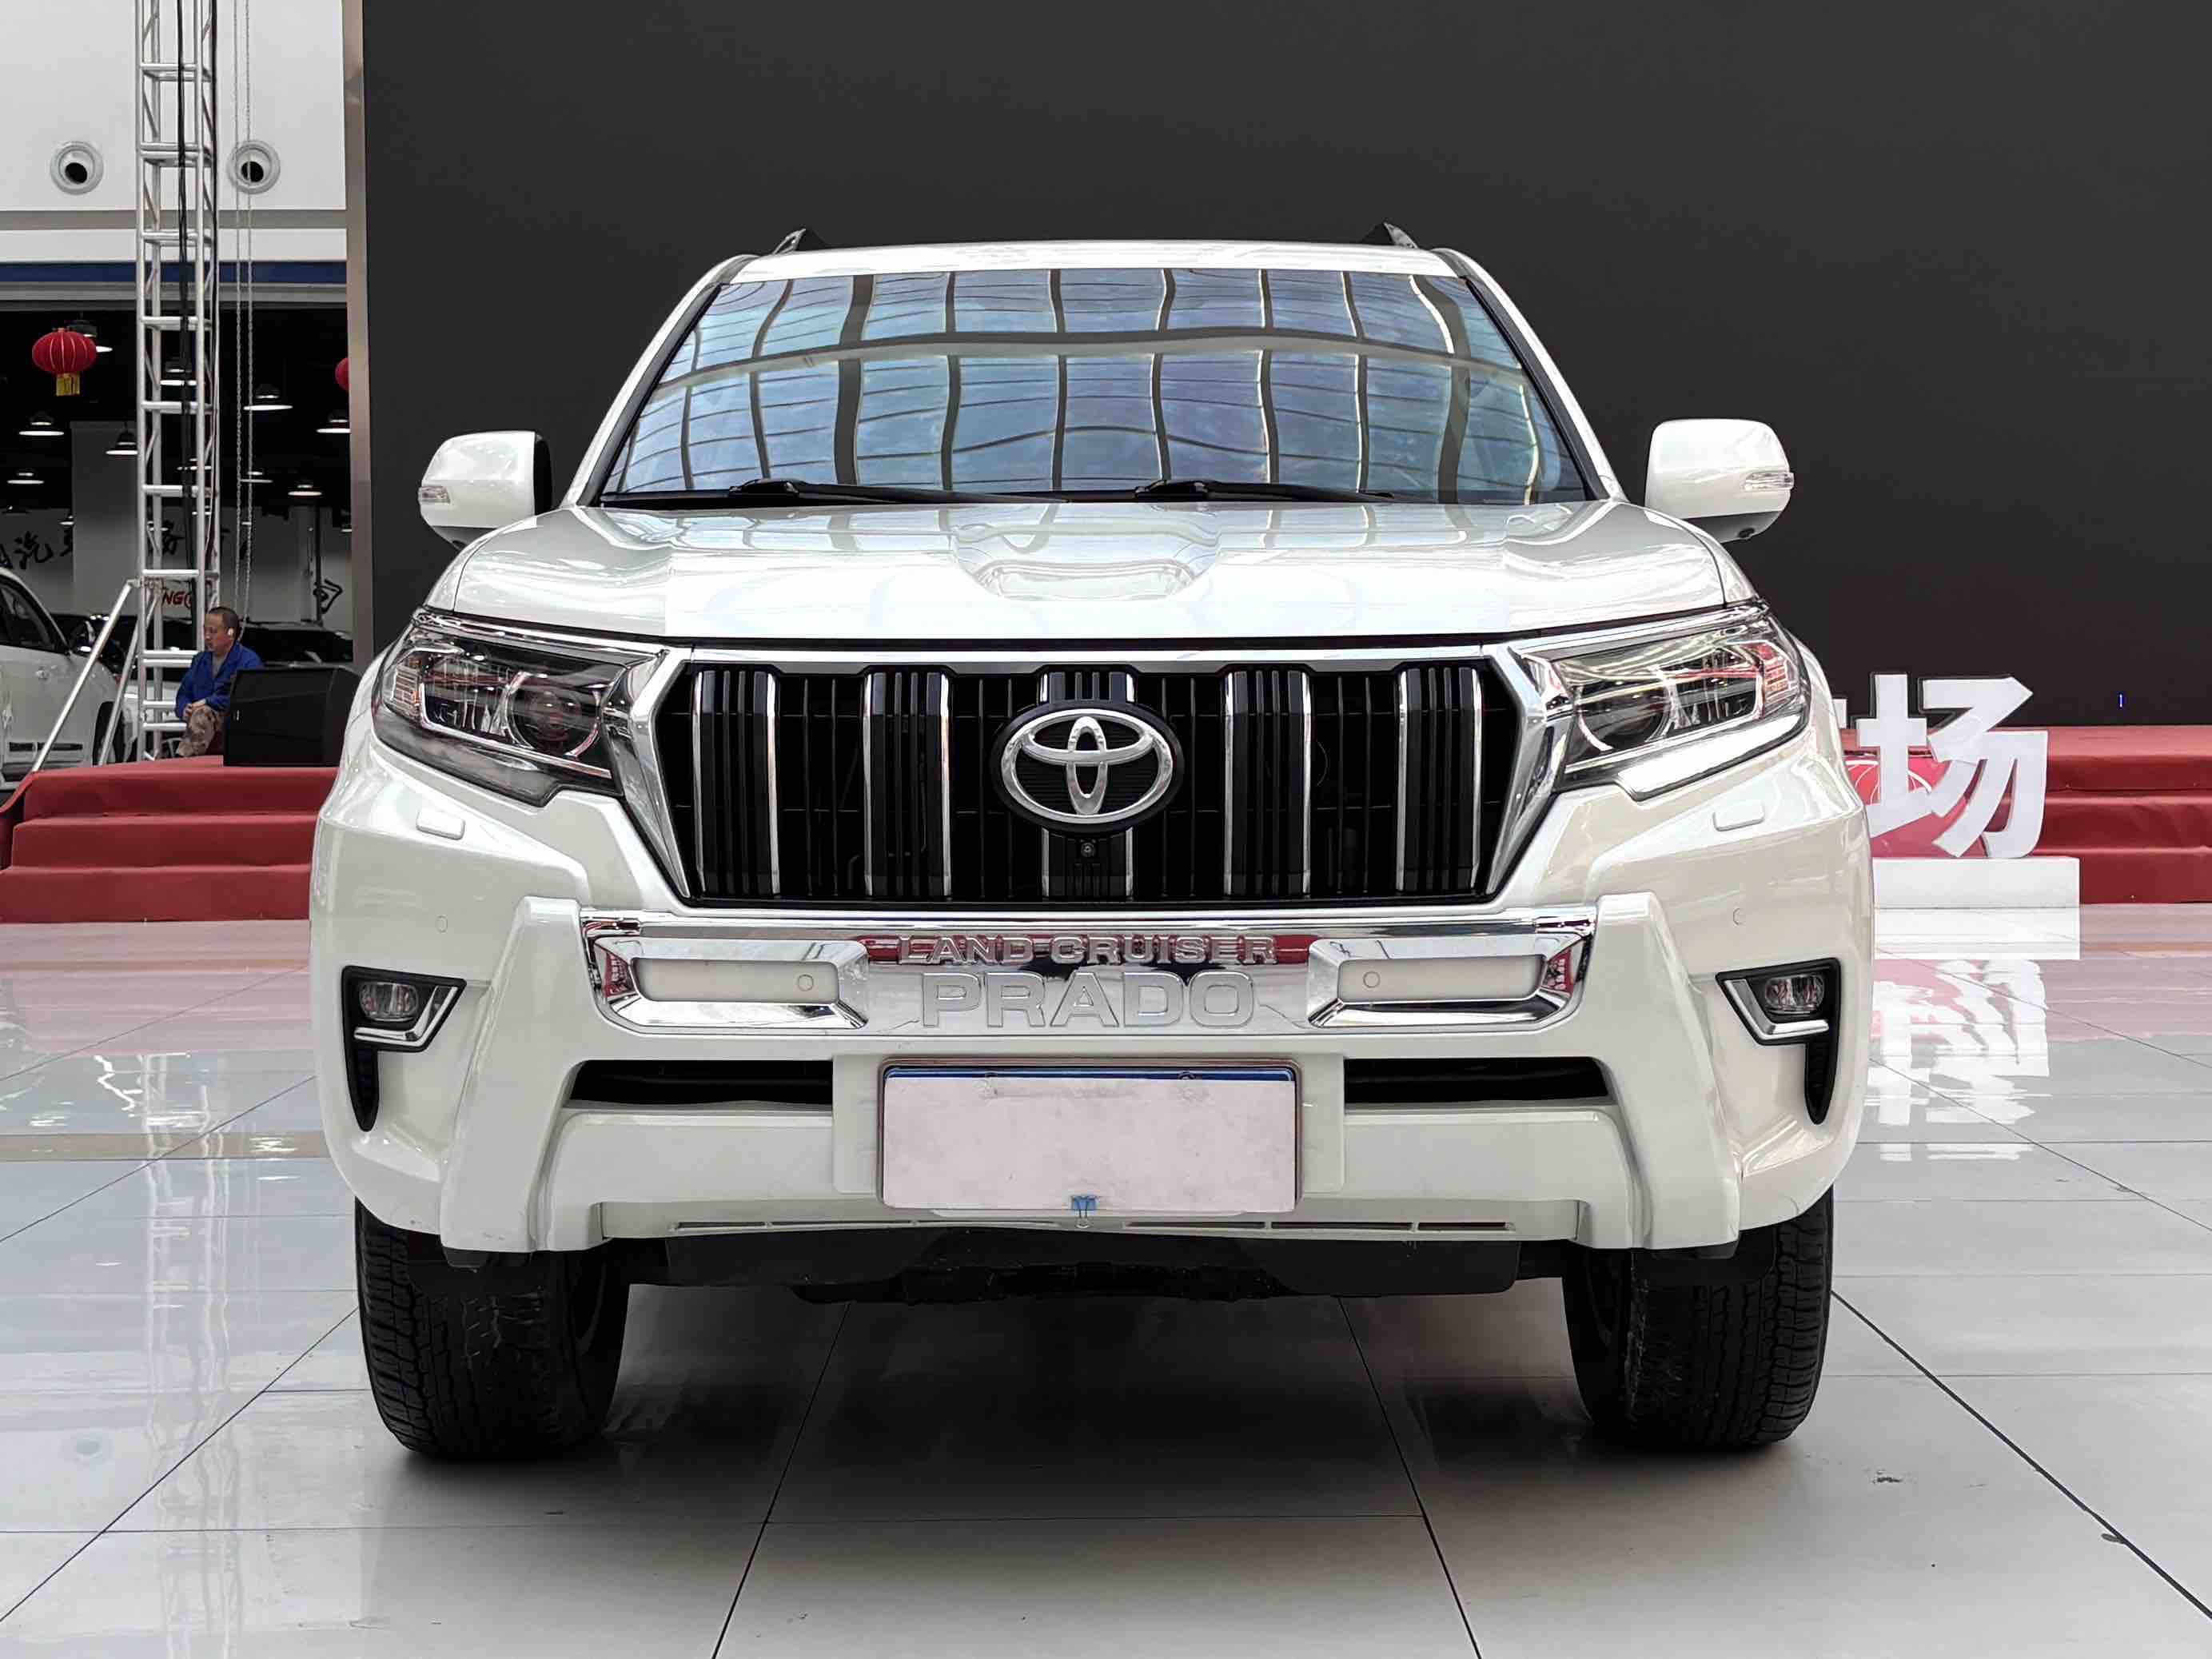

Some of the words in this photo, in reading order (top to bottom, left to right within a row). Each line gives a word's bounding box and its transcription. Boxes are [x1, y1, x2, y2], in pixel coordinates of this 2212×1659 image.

[1833, 673, 2049, 859] 场
[898, 935, 1034, 964] LAND
[1050, 935, 1277, 965] CRUISER
[922, 970, 1254, 1028] PRADO
